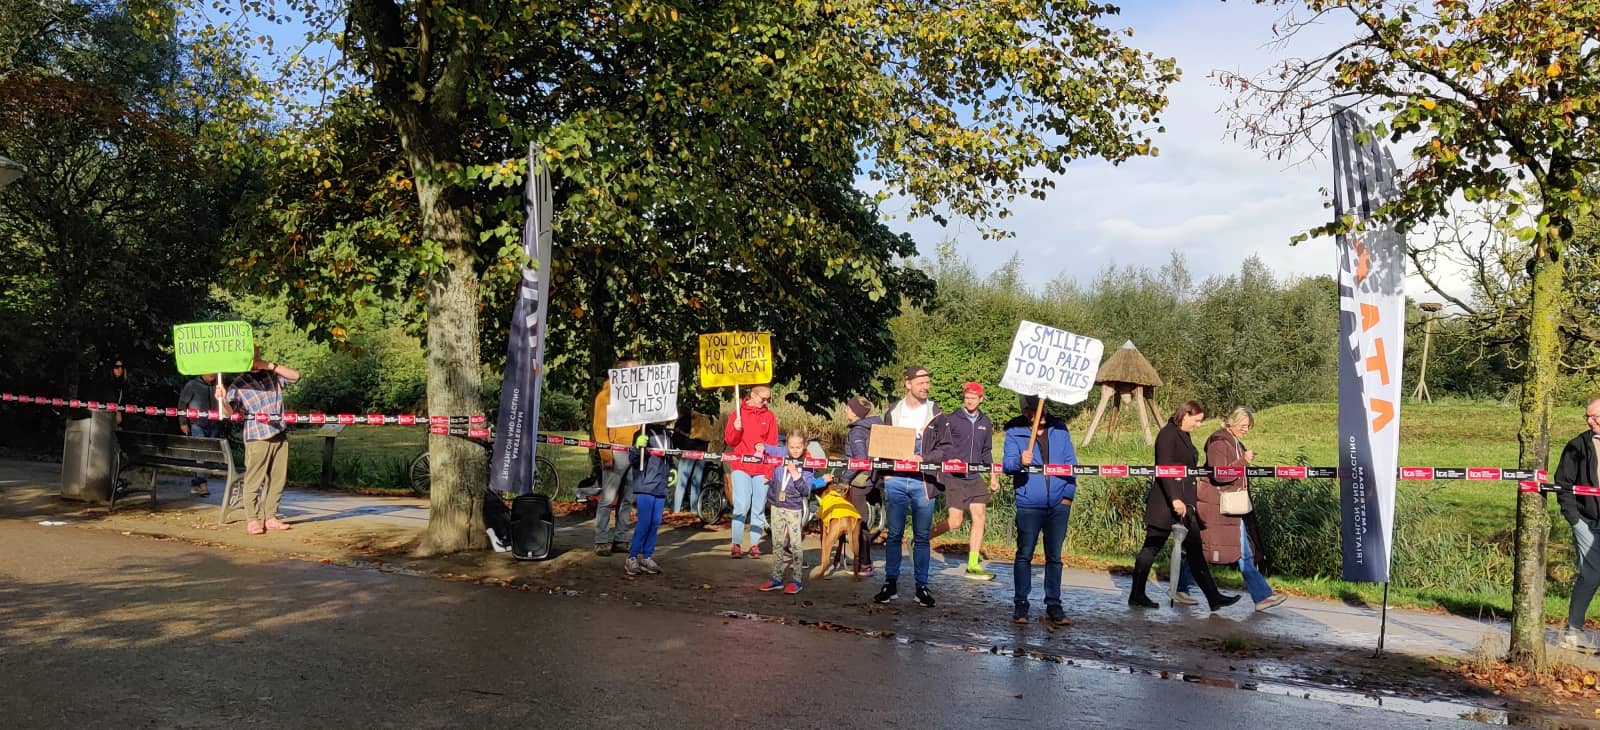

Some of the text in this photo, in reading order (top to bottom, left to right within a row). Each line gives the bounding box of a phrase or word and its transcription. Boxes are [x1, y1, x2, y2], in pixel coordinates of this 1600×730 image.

[177, 323, 251, 340] STILL SMILING?
[706, 332, 761, 348] YOU LOOK
[1030, 326, 1092, 353] SMILE!
[178, 339, 246, 355] RUN FASTER!
[705, 345, 766, 362] HOT WHEN
[1019, 340, 1091, 372] YOU PAID
[611, 365, 673, 385] REMEMBER
[704, 359, 768, 376] YOU SWEAT
[1014, 358, 1036, 376] TO
[1037, 364, 1056, 382] DO
[1059, 369, 1090, 389] THIS
[615, 380, 677, 401] YOU LOVE
[628, 396, 668, 414] THIS!
